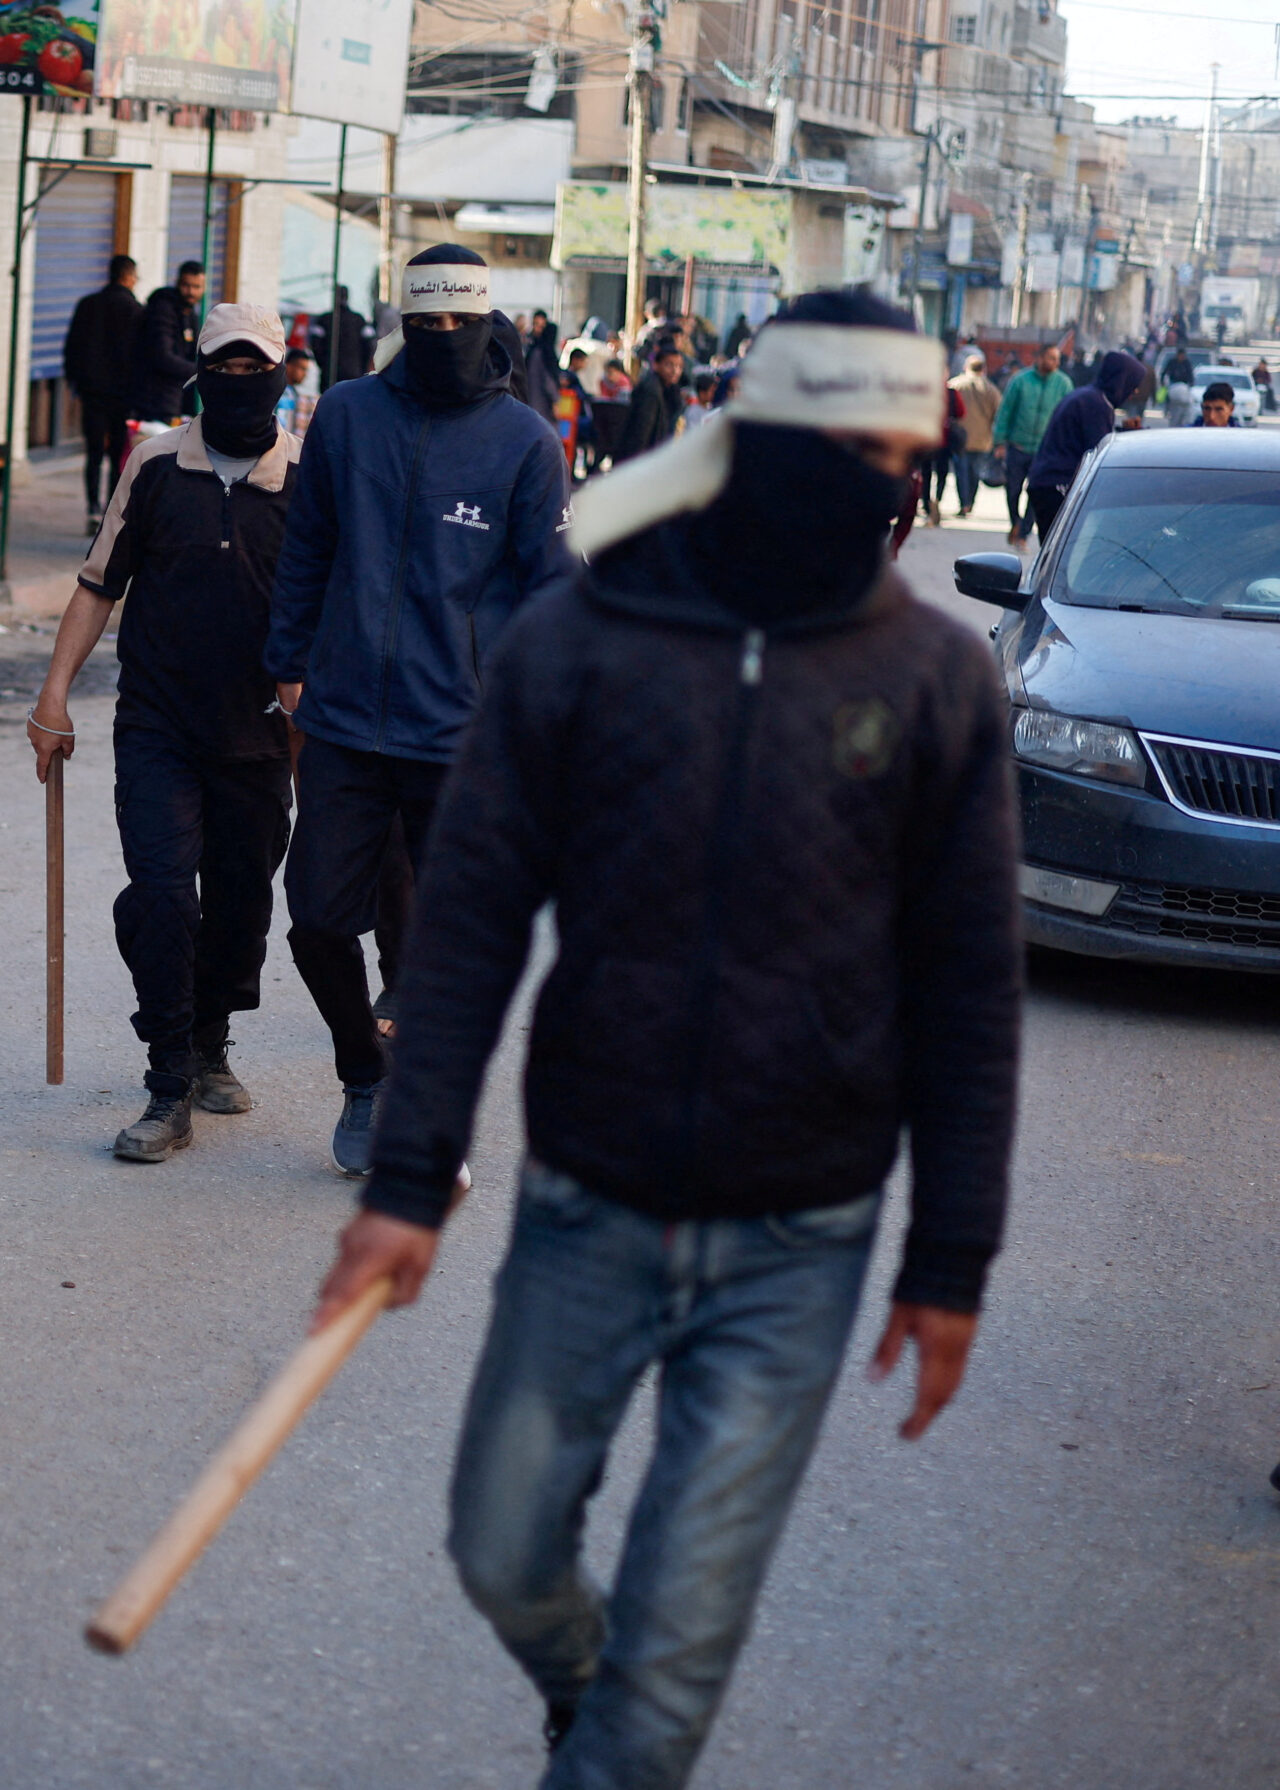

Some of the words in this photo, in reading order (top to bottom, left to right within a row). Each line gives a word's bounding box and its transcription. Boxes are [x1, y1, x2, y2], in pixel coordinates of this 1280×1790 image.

[409, 281, 440, 298] الشعبية
[442, 280, 475, 297] الحماية
[442, 514, 463, 524] UNDER
[464, 518, 490, 531] ARMOUR
